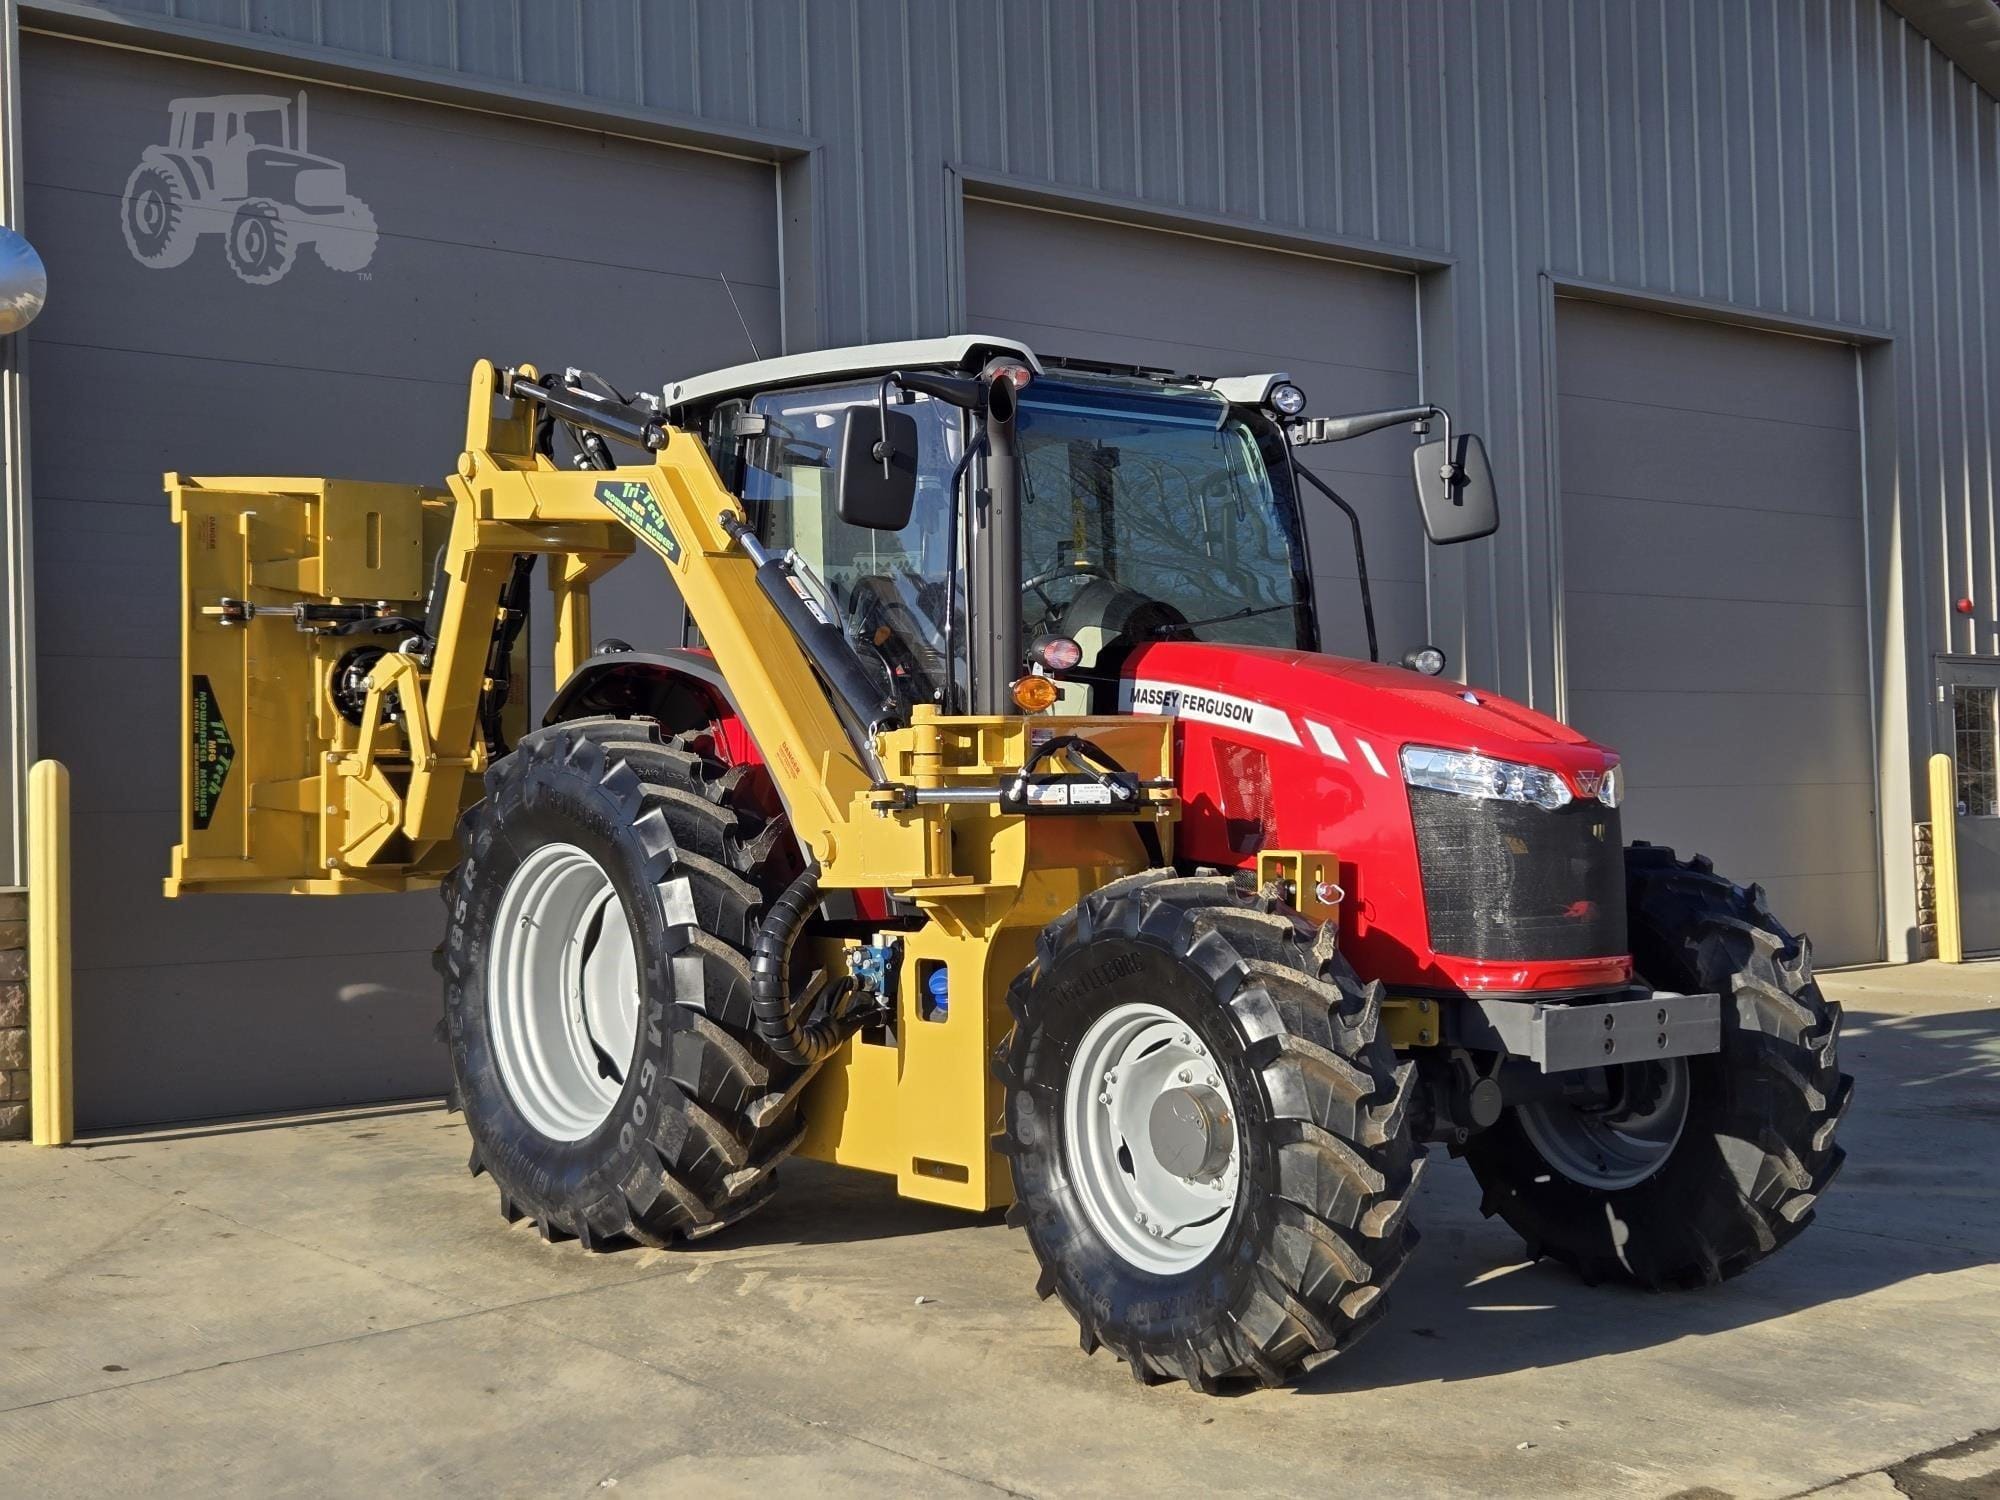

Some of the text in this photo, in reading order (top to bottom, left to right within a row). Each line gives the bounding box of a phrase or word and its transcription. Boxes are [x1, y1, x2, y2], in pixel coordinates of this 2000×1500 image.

[1129, 687, 1253, 723] MASSEY FERGUSON
[208, 740, 217, 762] MFG
